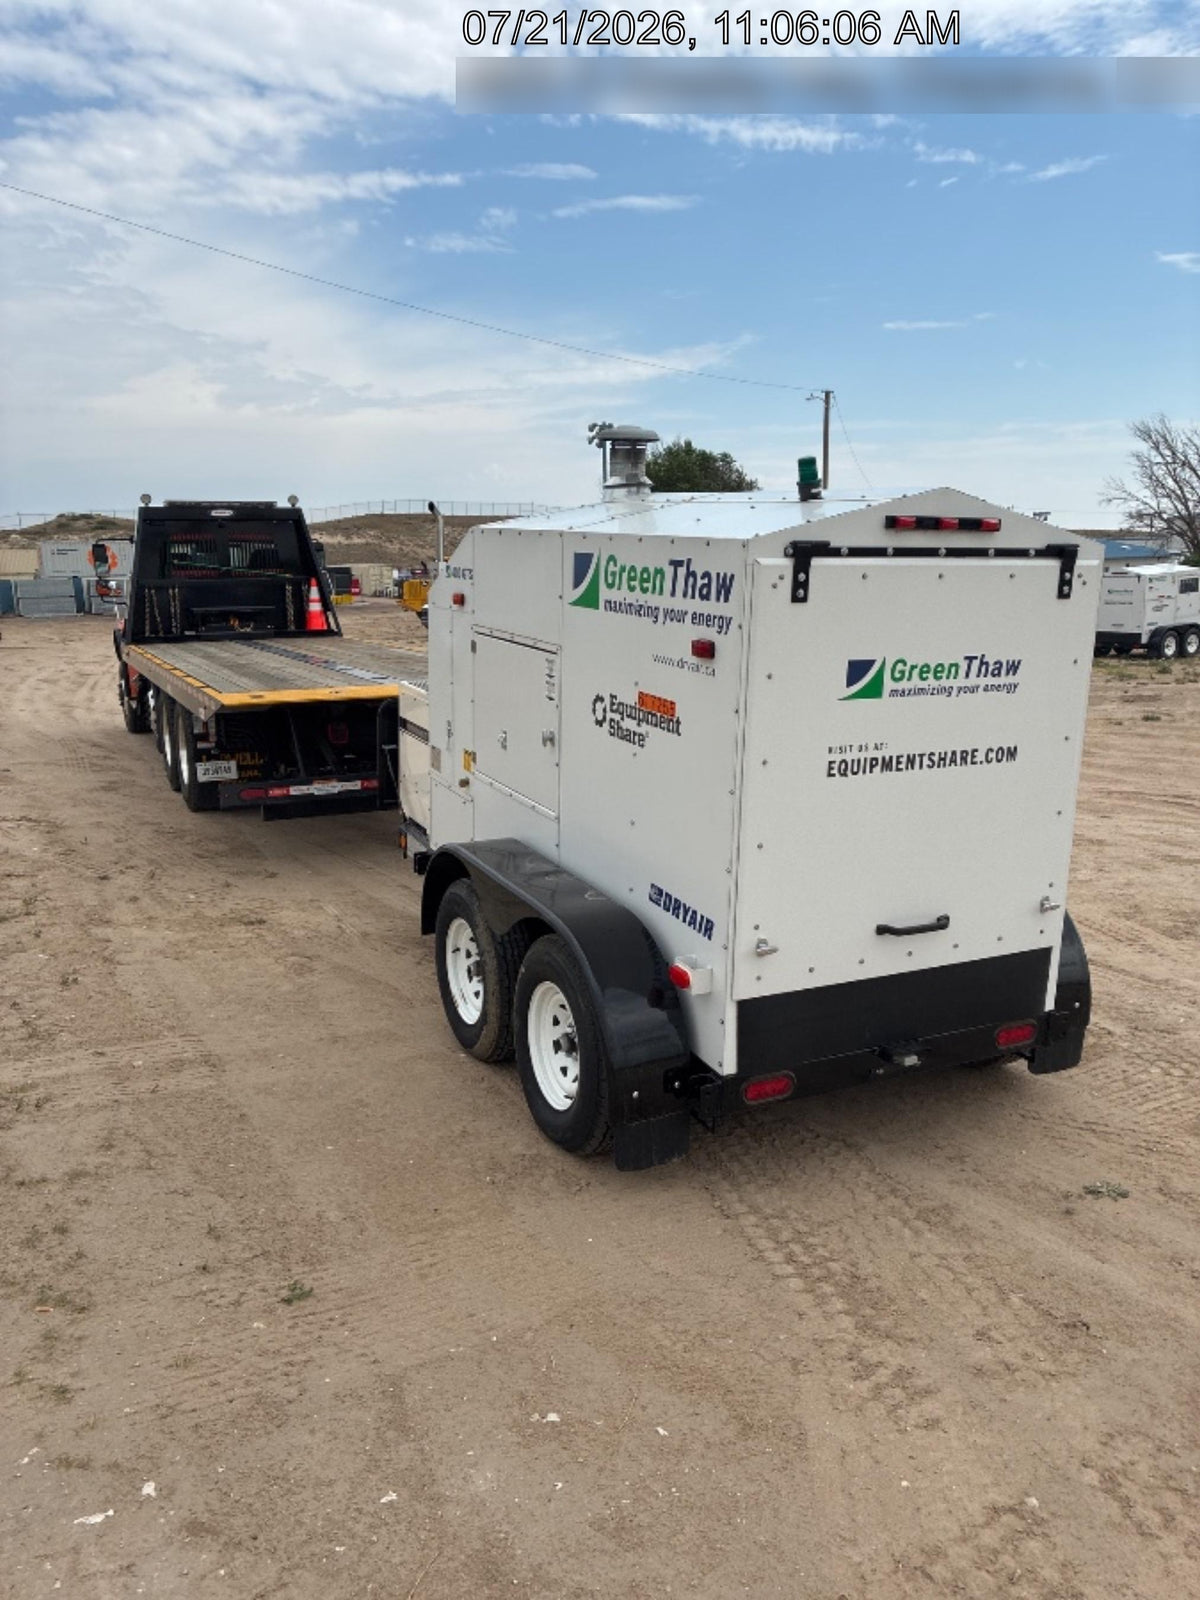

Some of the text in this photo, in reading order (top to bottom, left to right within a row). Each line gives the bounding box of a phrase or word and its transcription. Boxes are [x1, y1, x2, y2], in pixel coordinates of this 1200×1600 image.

[603, 597, 734, 636] maximizing your energy
[888, 681, 1021, 699] maximizing your energy
[608, 692, 682, 738] Equipment
[826, 744, 1019, 779] EQUIPMENTSHARE.COM
[662, 891, 716, 942] DRYAIR
